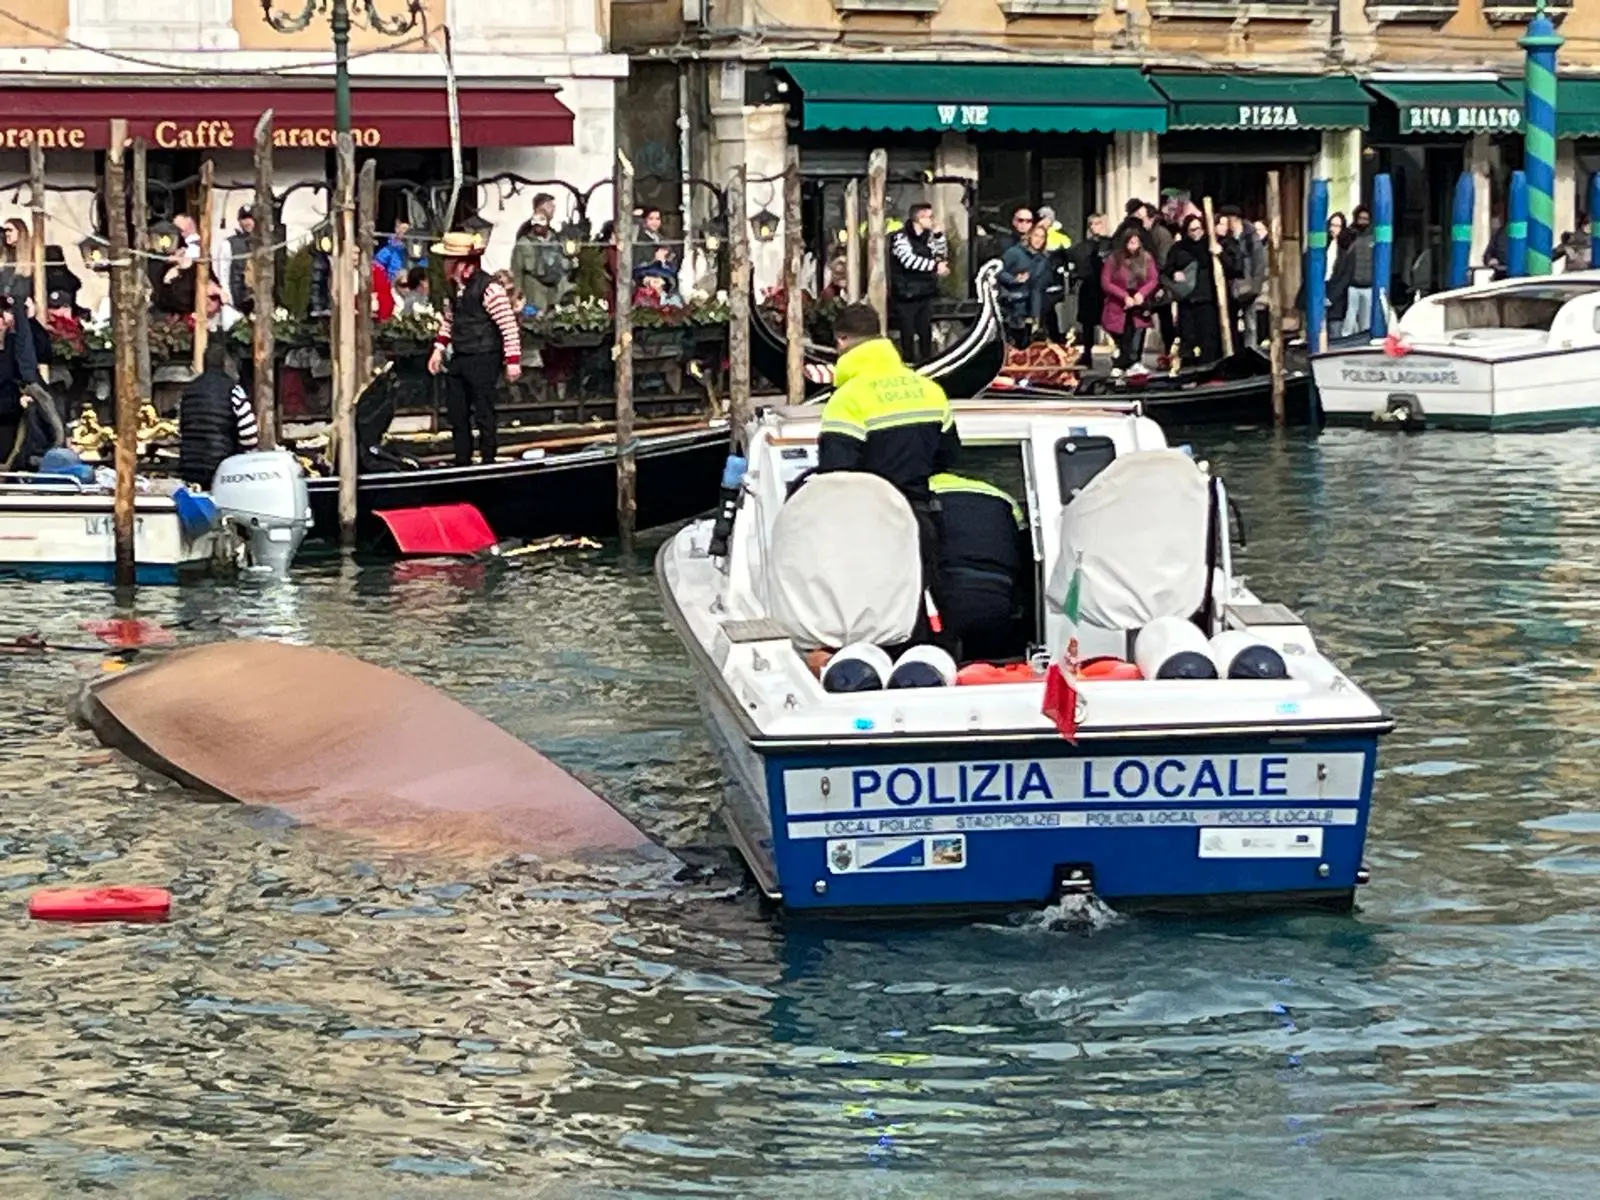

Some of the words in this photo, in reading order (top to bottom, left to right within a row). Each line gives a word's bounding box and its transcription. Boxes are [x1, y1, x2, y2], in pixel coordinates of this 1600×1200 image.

[937, 105, 988, 124] WNE
[1239, 106, 1298, 124] PIZZA
[1410, 107, 1451, 126] RIVA
[1458, 107, 1520, 127] RIALTO
[155, 120, 234, 148] Caffè
[220, 471, 282, 484] HONDA
[852, 761, 1053, 808] POLIZIA
[1083, 757, 1288, 799] LOCALE
[824, 819, 875, 836] LOCAL
[879, 817, 933, 833] POLICE
[1086, 812, 1145, 826] POLICIA
[1149, 810, 1198, 825] LOCAL
[1219, 809, 1272, 824] POLICE
[1275, 808, 1334, 823] LOCALE
